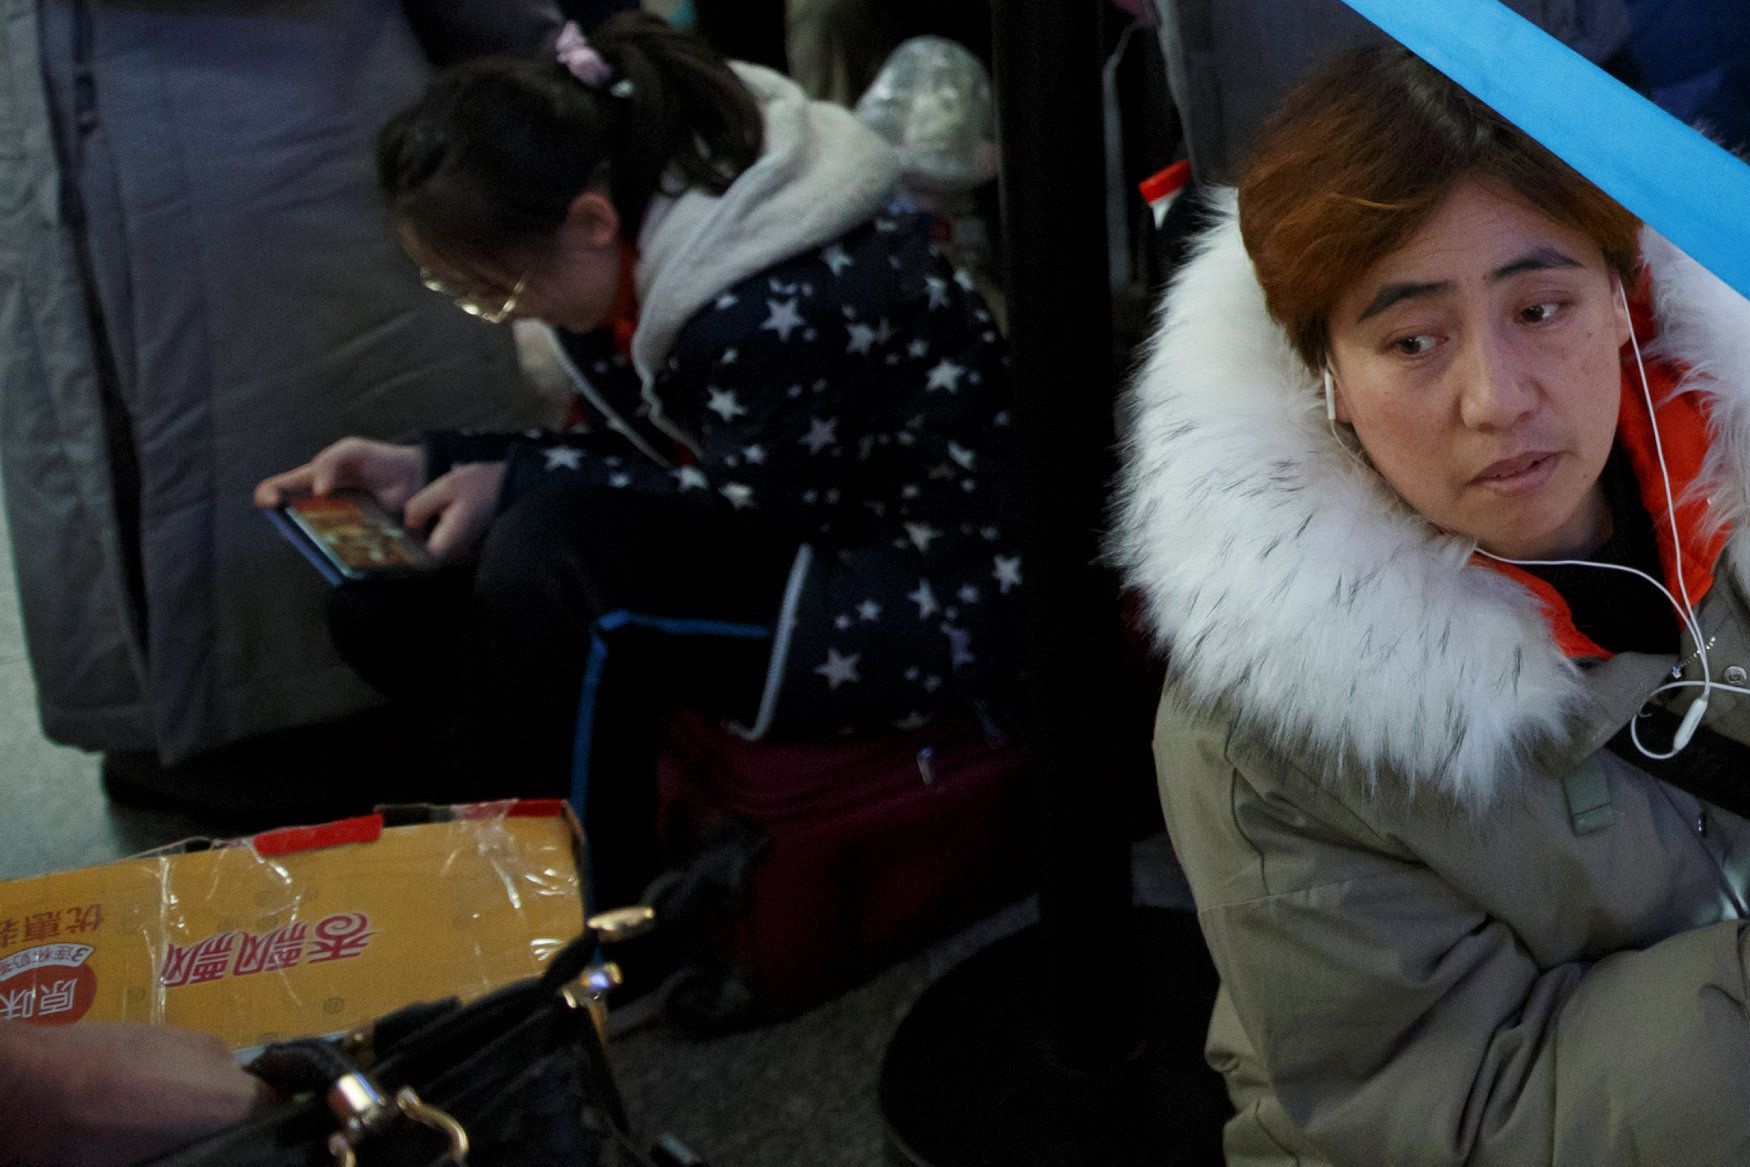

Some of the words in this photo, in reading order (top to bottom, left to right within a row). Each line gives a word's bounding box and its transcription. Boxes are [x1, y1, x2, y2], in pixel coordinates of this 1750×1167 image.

[161, 912, 378, 988] 香飘飘
[0, 978, 78, 1020] 原味
